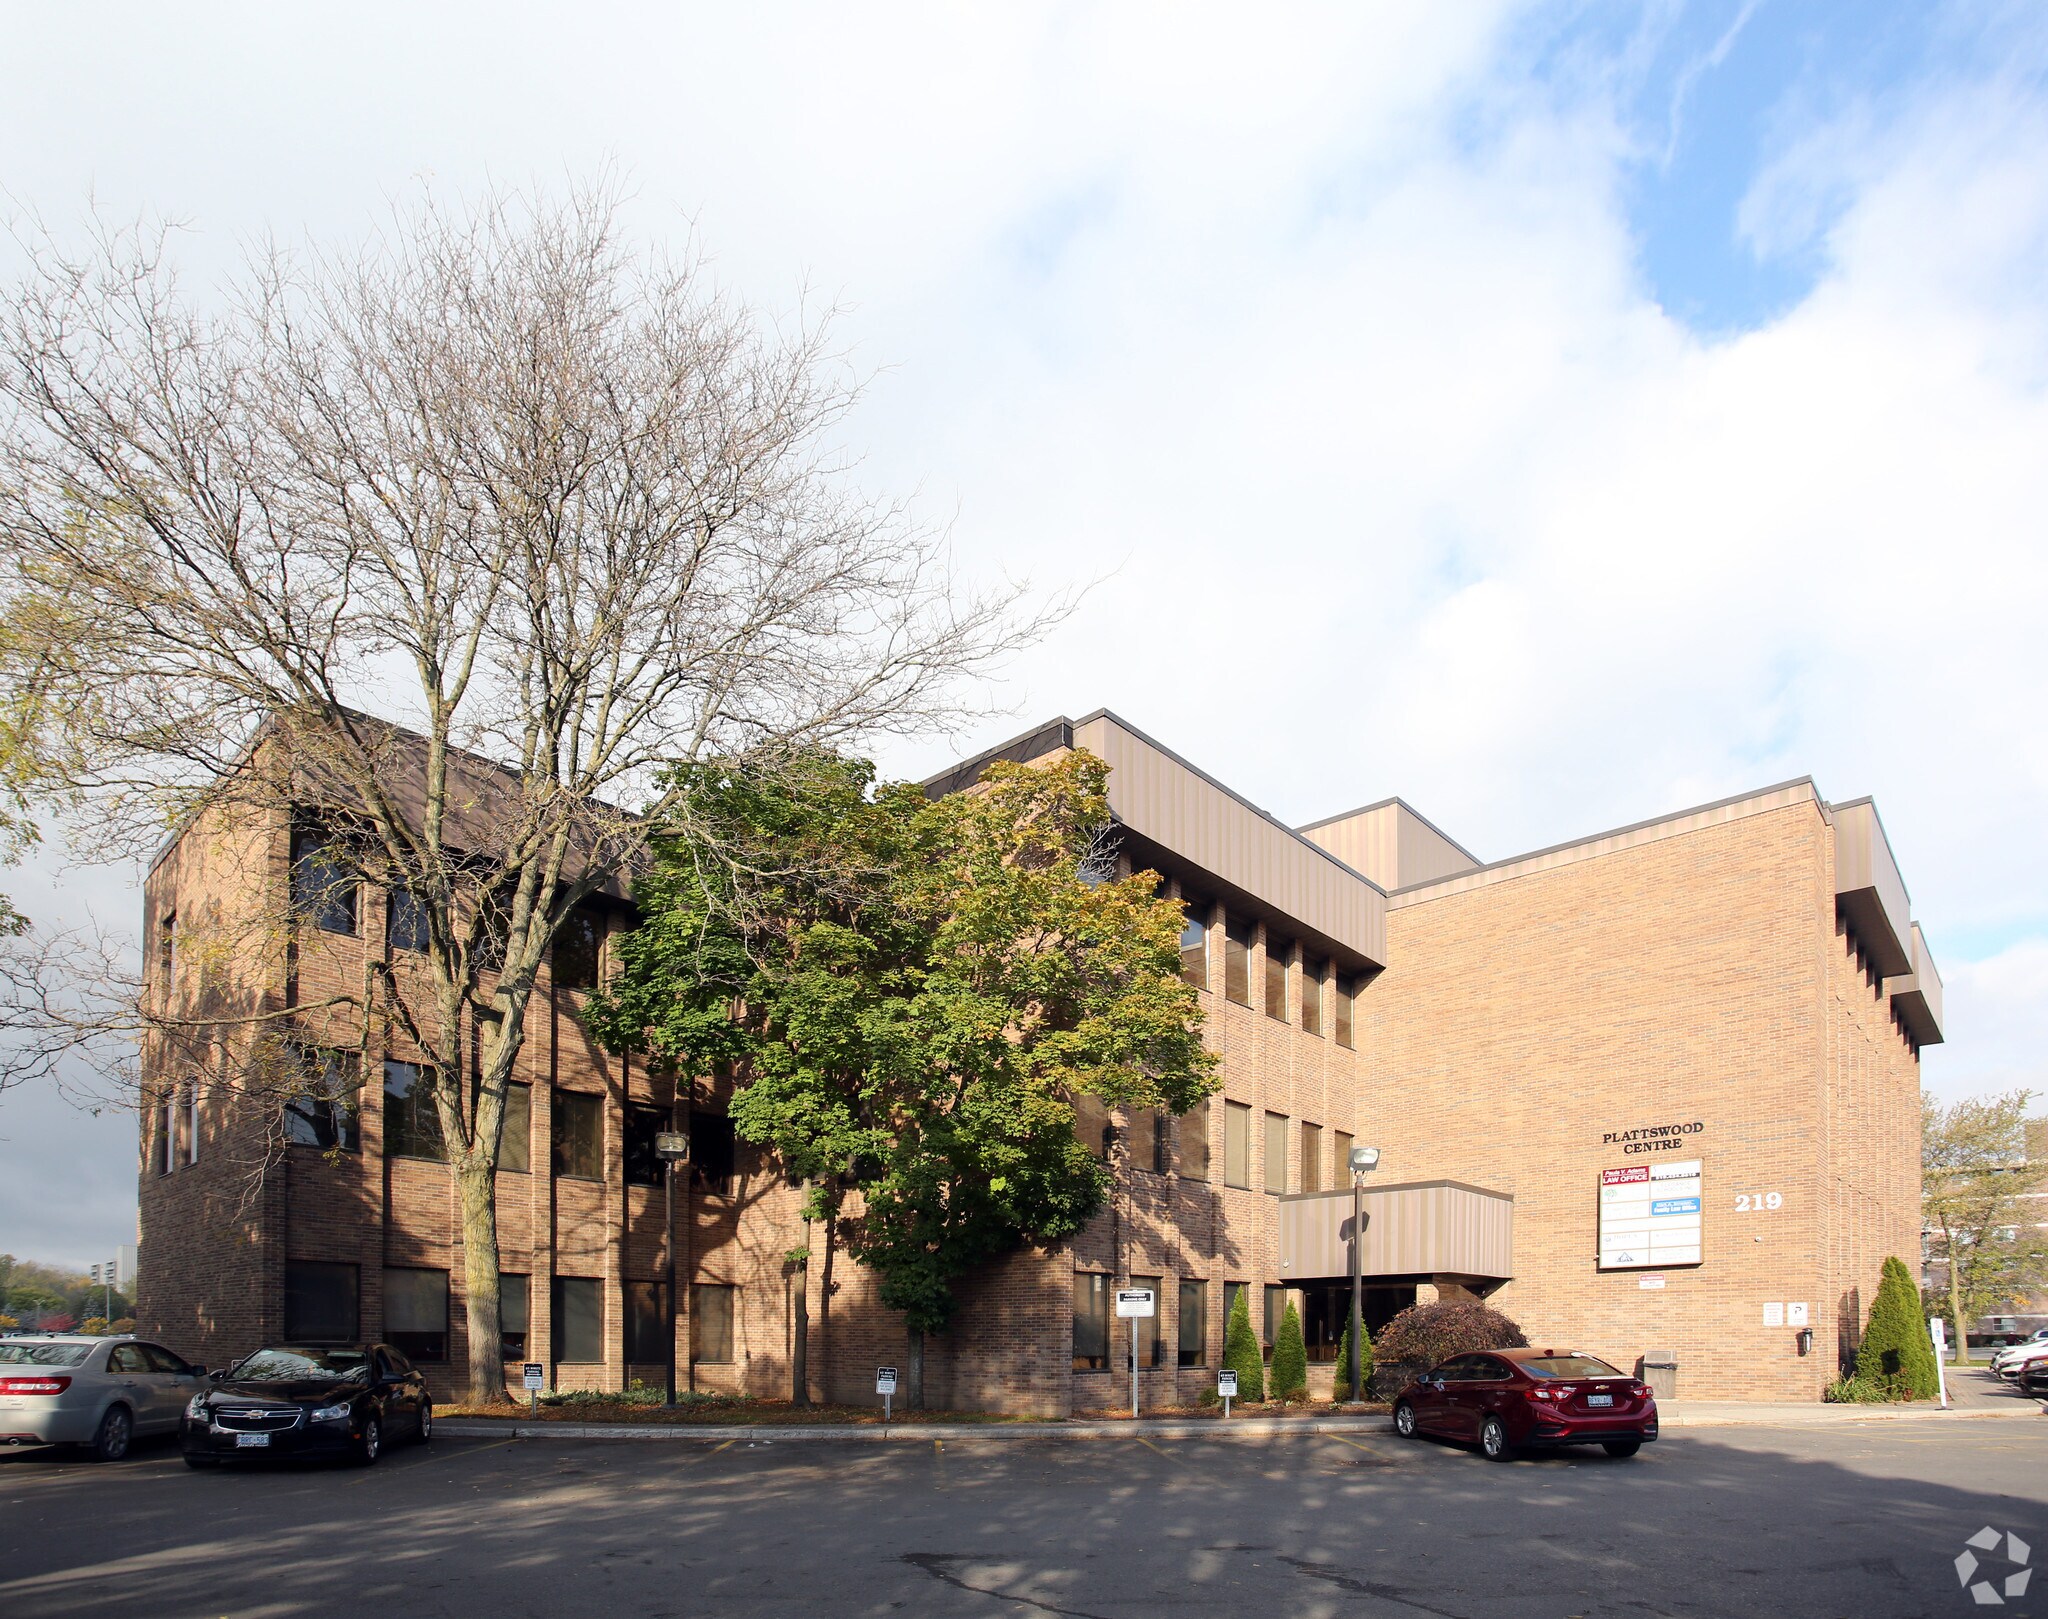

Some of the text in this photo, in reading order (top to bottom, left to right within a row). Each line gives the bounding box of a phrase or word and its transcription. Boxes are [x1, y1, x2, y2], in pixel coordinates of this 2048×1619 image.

[1603, 1122, 1704, 1143] PLATTSWOOD
[1623, 1138, 1683, 1154] CENTRE
[1620, 1174, 1647, 1183] OFFICE
[1735, 1192, 1783, 1212] 219
